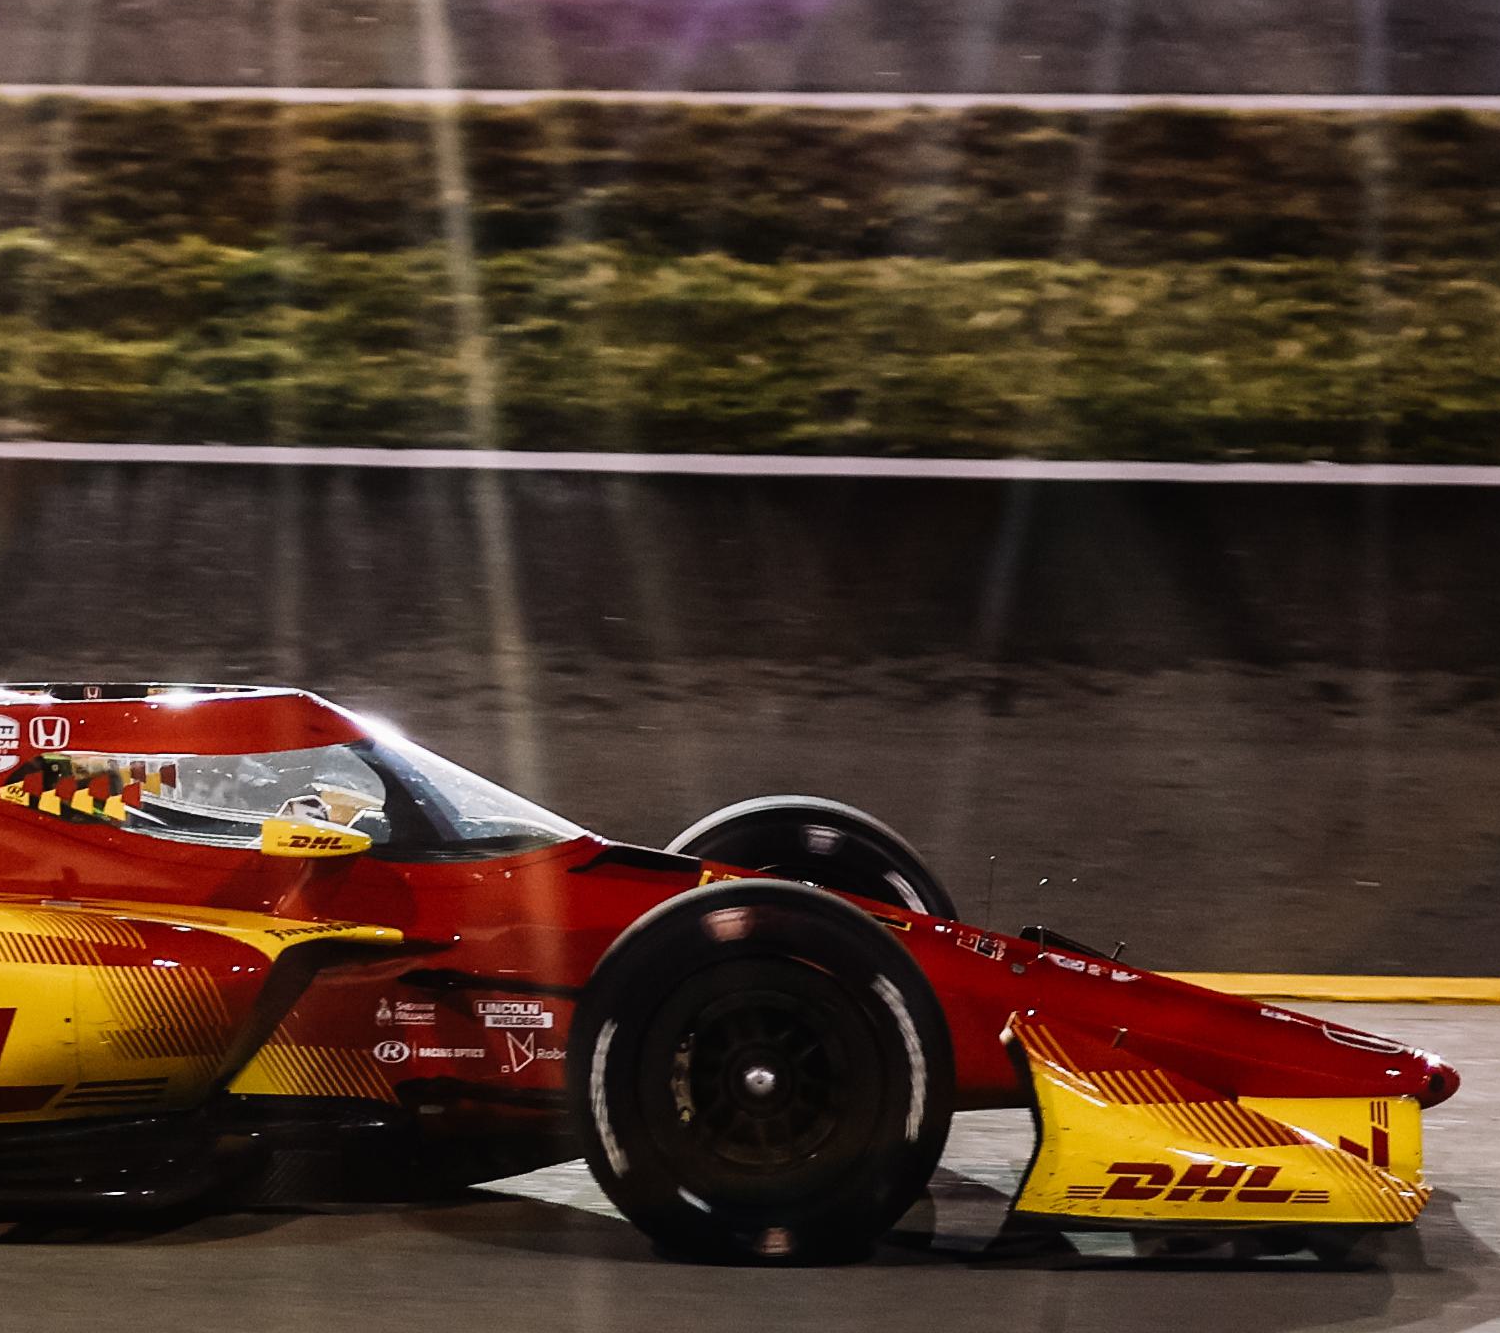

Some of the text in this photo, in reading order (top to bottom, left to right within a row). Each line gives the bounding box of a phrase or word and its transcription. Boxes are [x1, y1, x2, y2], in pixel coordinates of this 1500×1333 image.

[288, 835, 345, 849] DHL
[478, 1003, 540, 1015] LINCOLN
[492, 1016, 546, 1026] WELDERS
[1102, 1162, 1296, 1203] DHL
